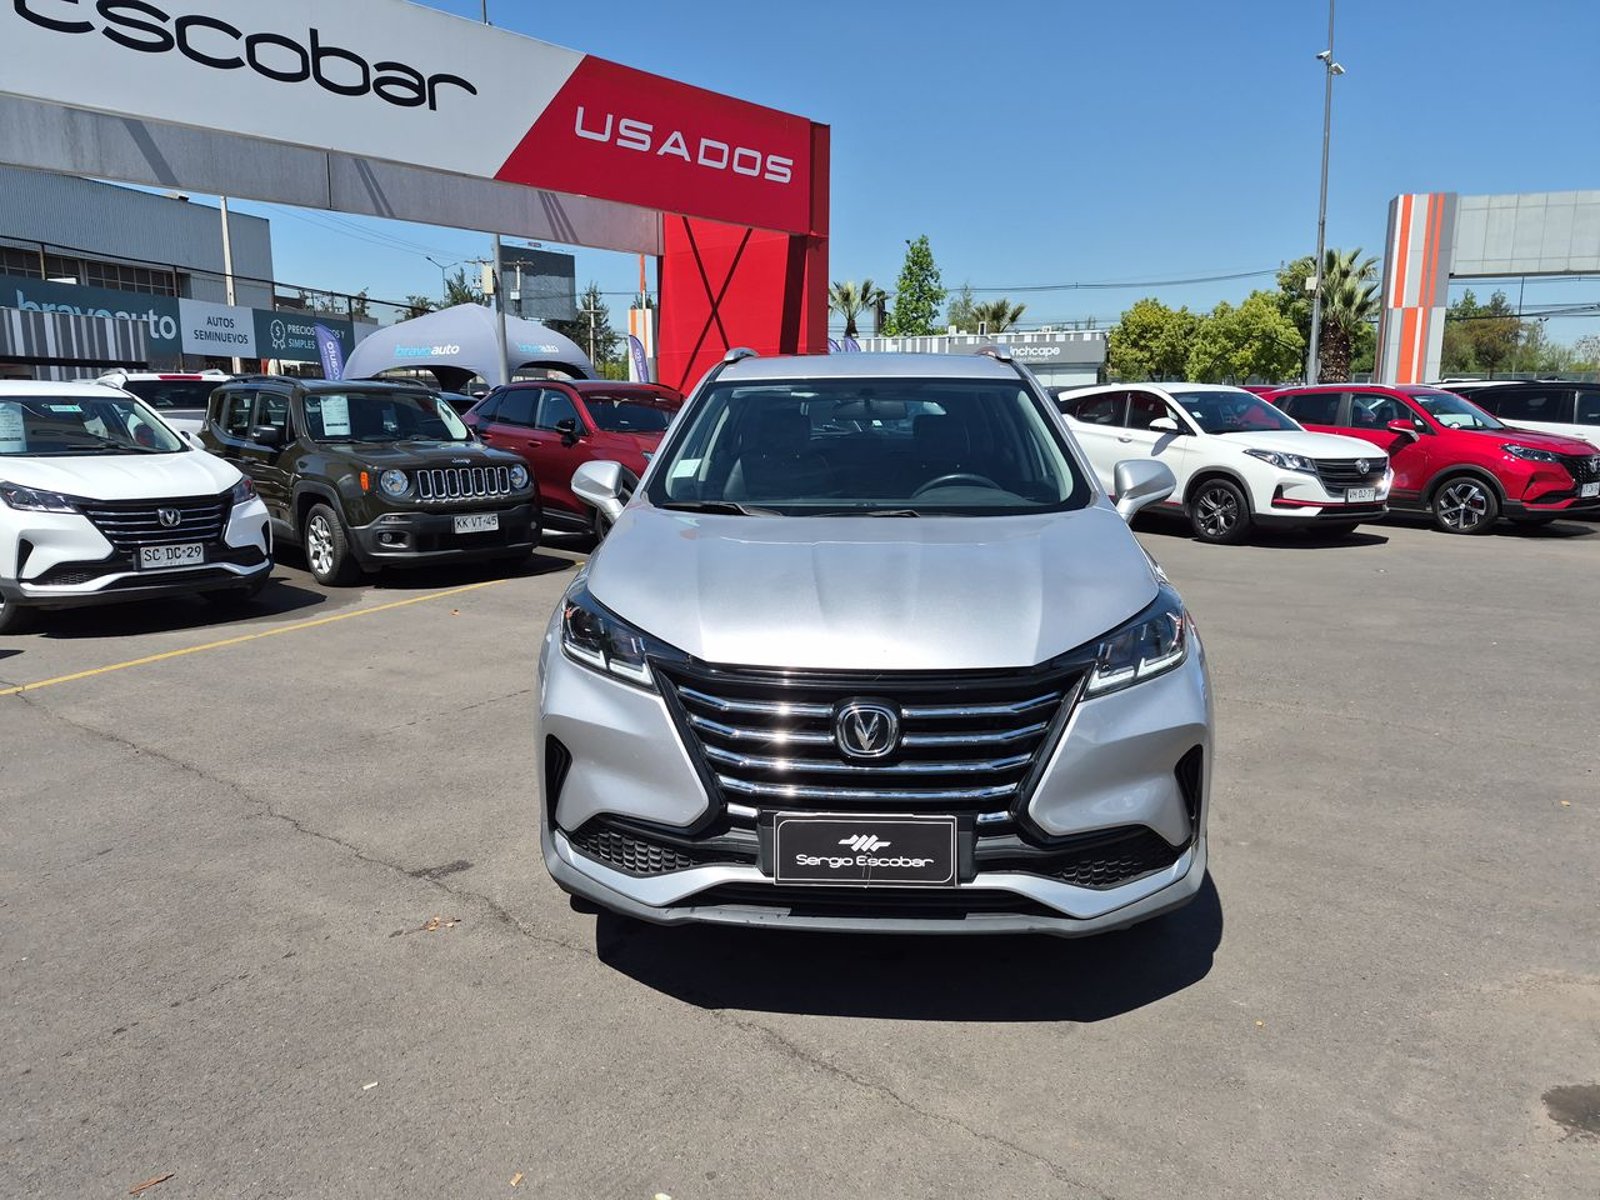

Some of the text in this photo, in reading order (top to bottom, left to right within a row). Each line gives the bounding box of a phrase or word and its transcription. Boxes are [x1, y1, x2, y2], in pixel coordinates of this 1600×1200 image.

[575, 106, 794, 183] USADOS
[206, 315, 235, 329] AUTOS
[287, 324, 316, 336] PRECIOS
[193, 329, 249, 345] SEMINUEVOS
[288, 338, 316, 350] SIMPLES
[144, 548, 160, 561] SC
[856, 855, 935, 867] Escobar
